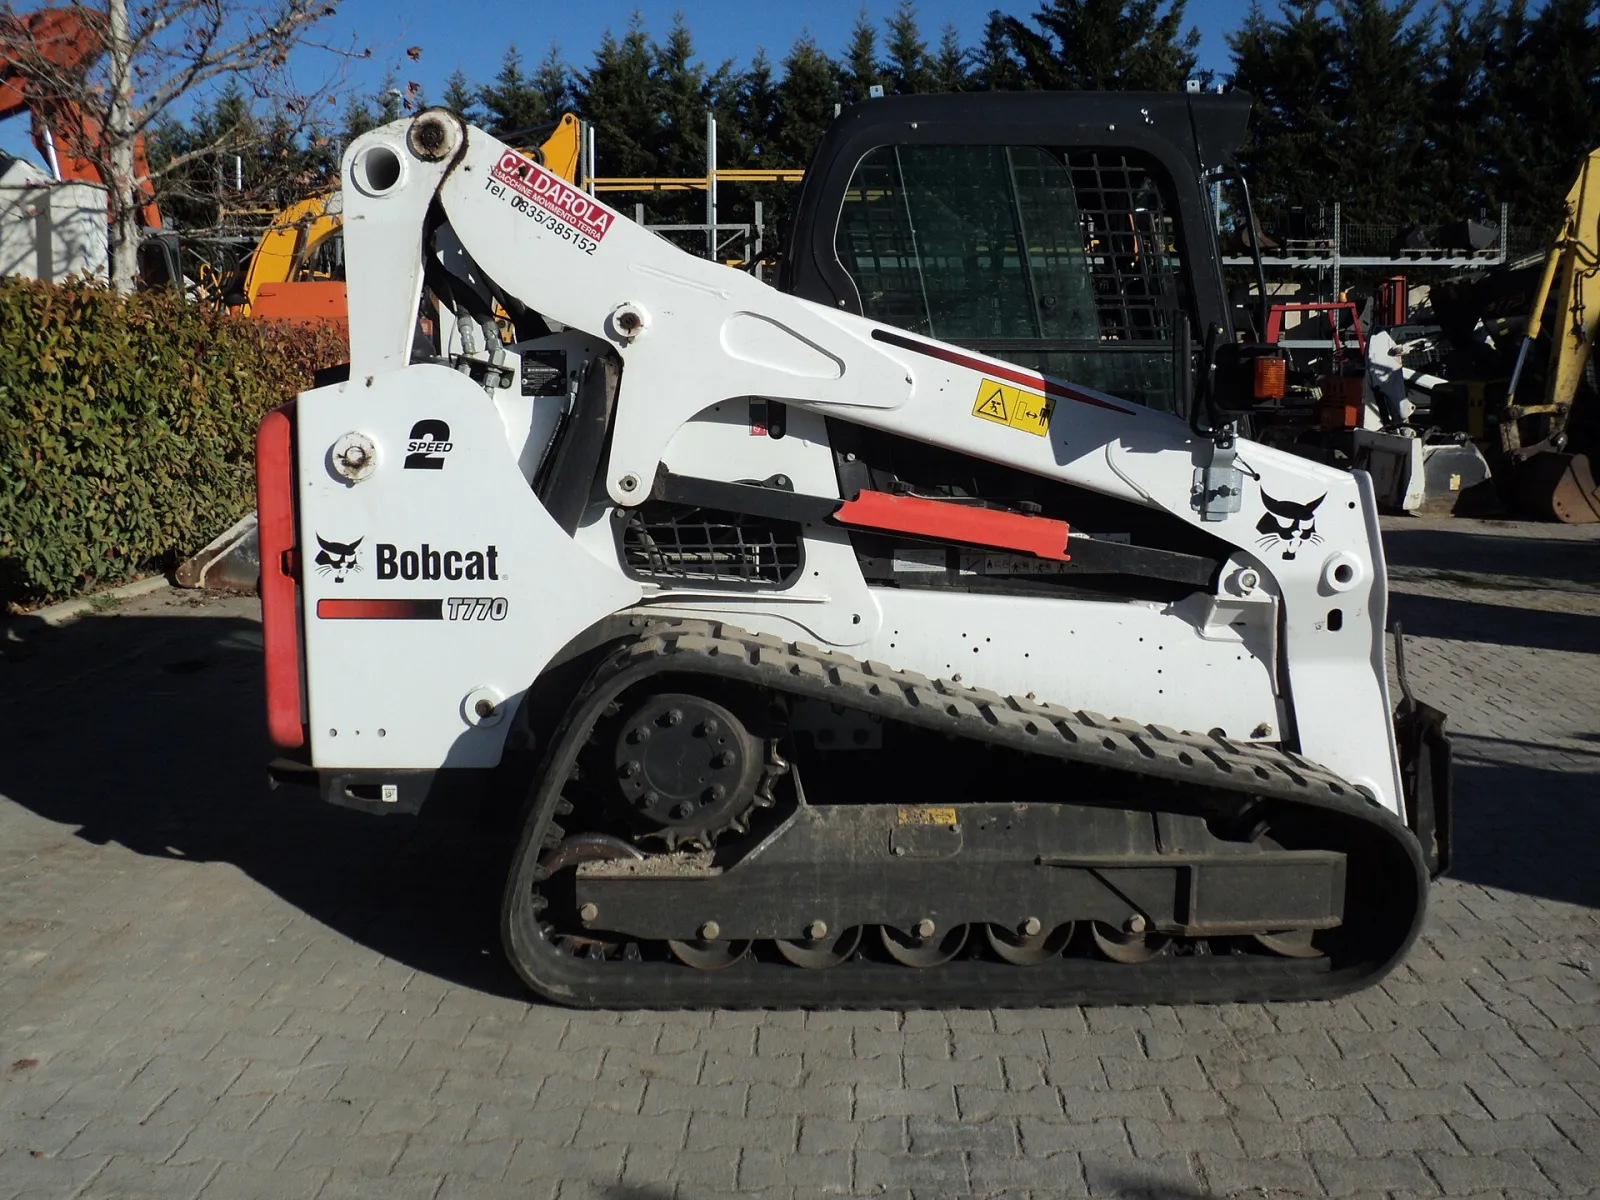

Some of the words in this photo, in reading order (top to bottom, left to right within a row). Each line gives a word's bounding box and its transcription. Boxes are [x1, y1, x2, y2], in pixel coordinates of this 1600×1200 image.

[484, 177, 506, 201] Tel.
[510, 195, 597, 255] 0835/385152
[500, 153, 609, 232] CALDAROLA
[532, 191, 577, 224] MOVIMENTO
[576, 219, 601, 240] TERRA
[404, 419, 451, 470] 2
[407, 442, 453, 452] SPEED
[376, 544, 499, 580] Bobcat
[447, 597, 508, 621] T770
